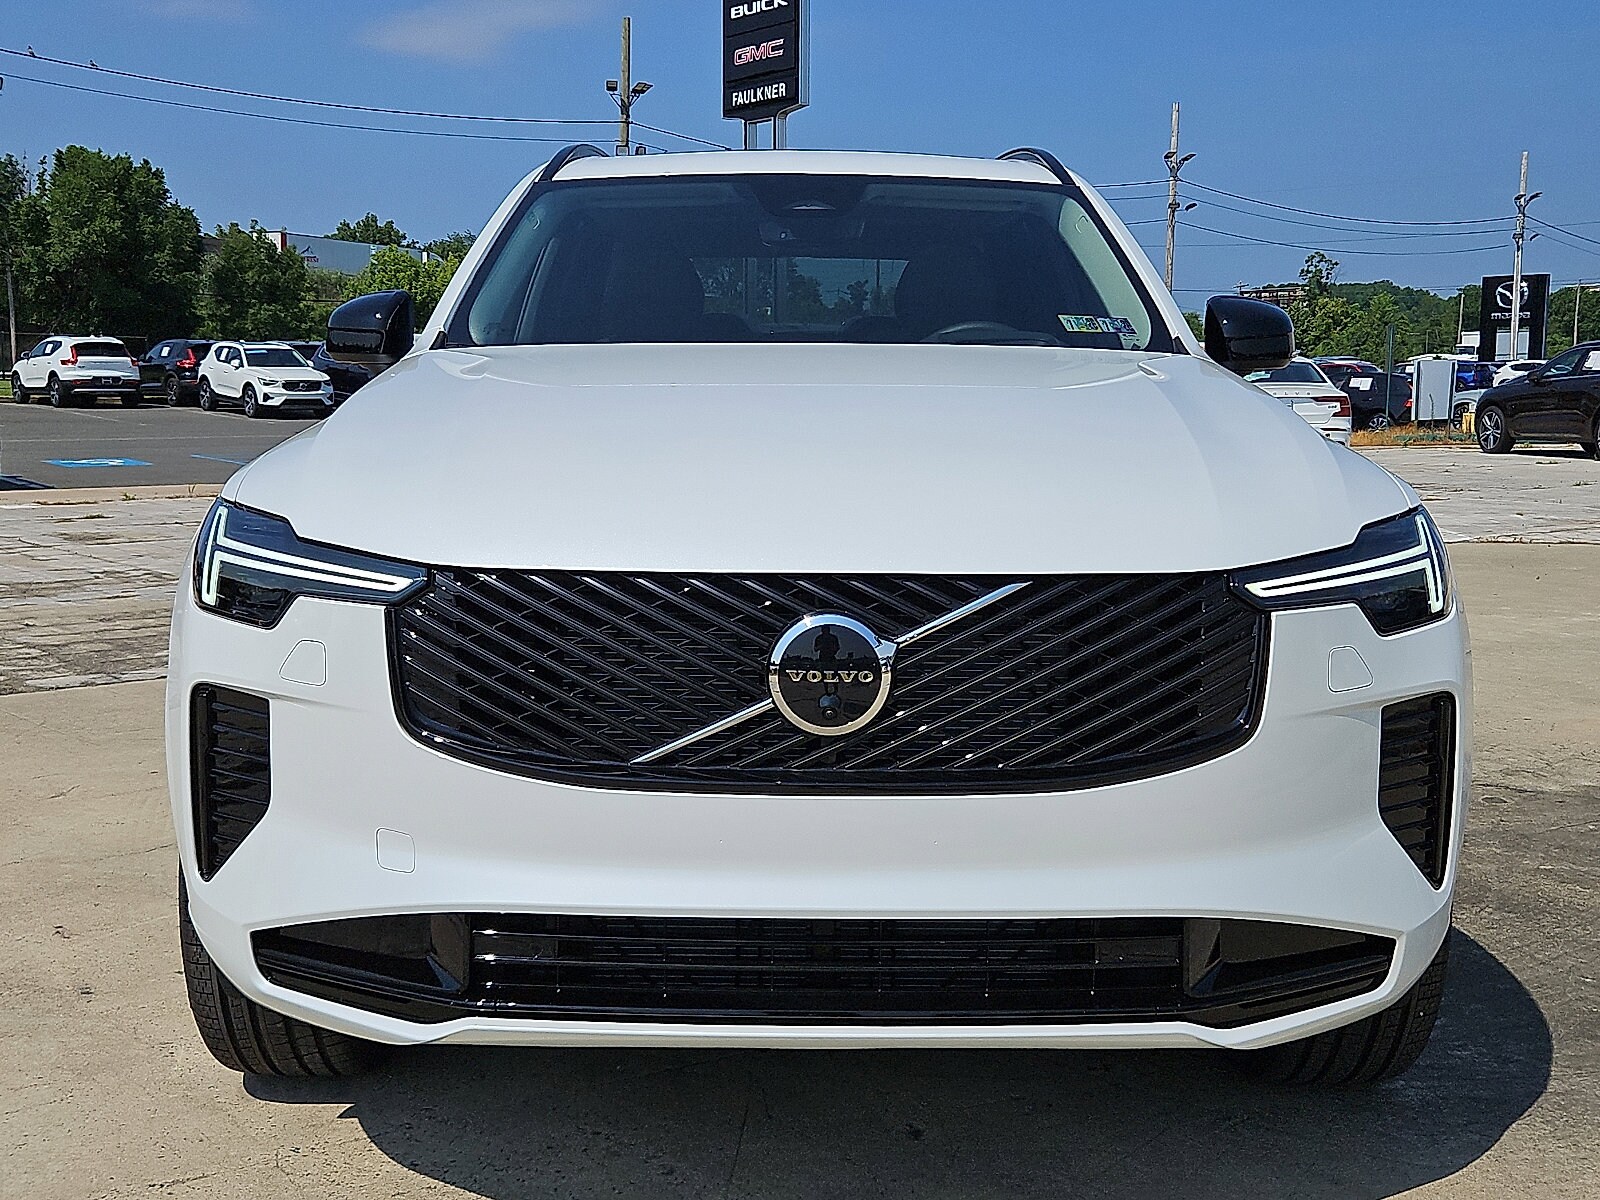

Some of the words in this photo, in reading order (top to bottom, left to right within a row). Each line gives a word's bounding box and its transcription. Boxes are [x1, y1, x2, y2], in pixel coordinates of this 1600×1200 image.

[734, 39, 785, 66] GMC
[732, 83, 786, 106] FAULKNER
[786, 670, 874, 683] VOLVO
